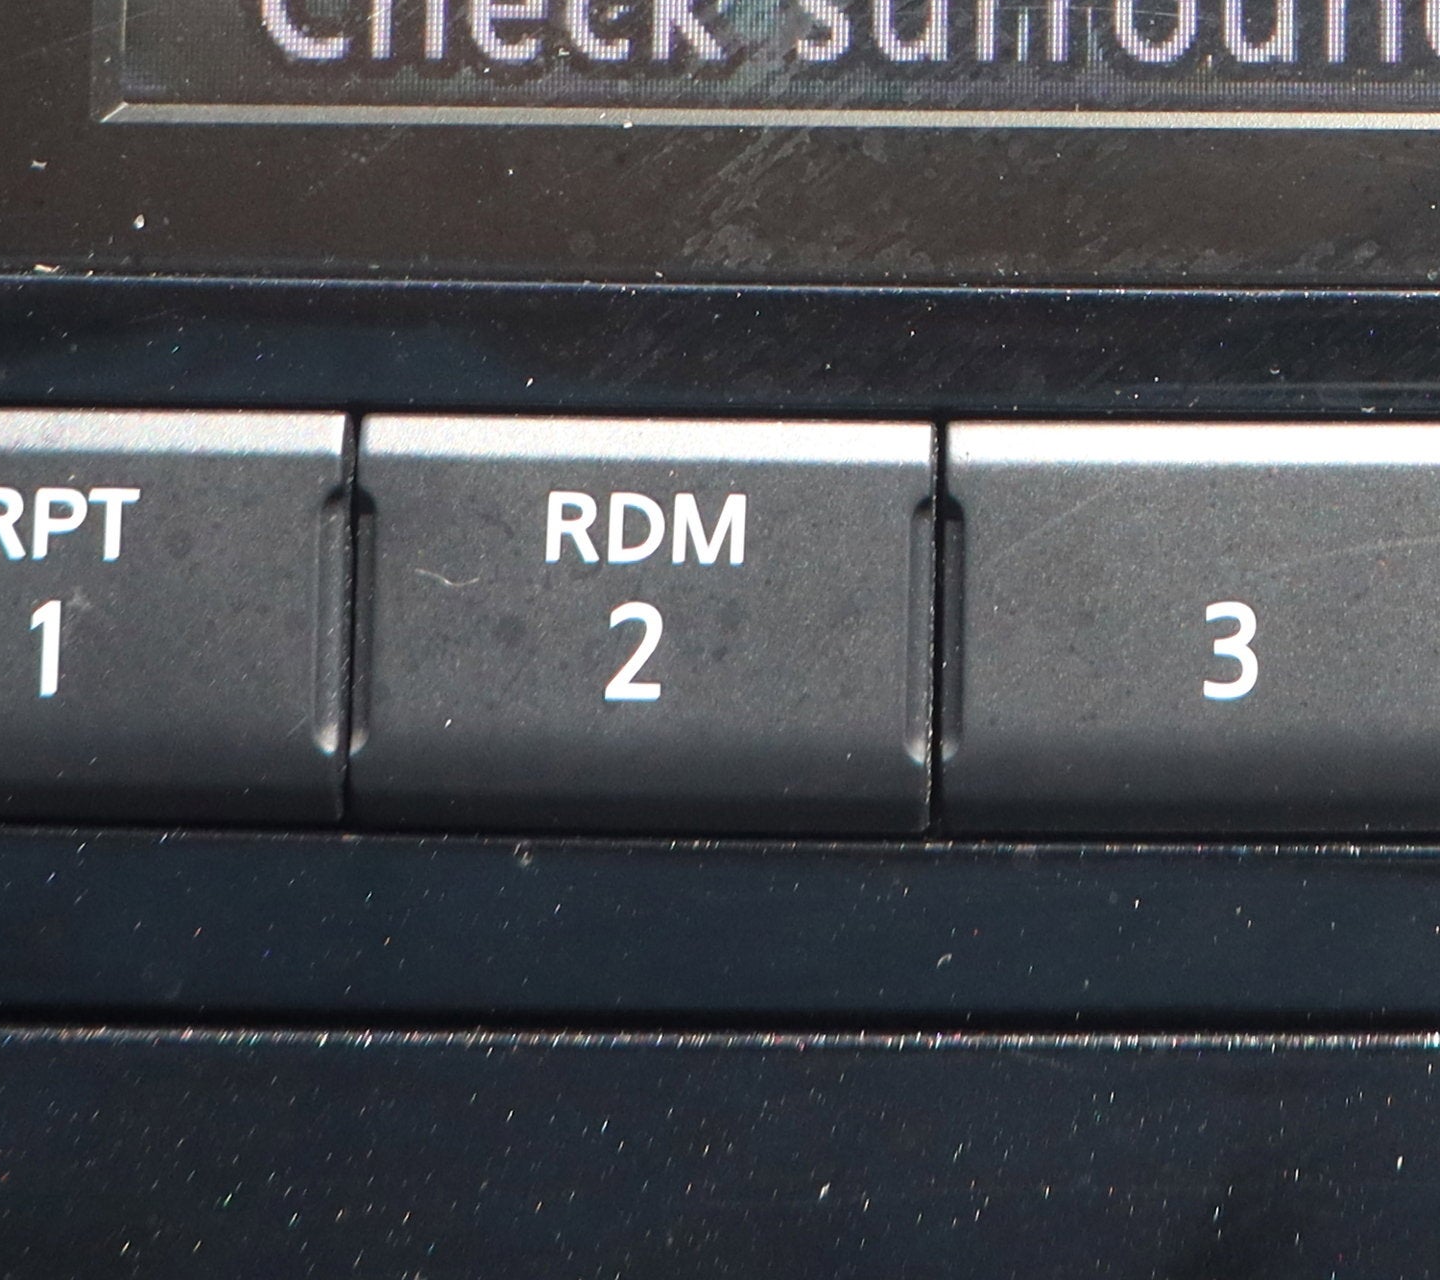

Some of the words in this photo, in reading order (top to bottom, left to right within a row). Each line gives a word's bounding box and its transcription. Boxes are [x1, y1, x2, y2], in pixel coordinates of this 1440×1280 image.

[544, 490, 748, 566] RDM
[29, 599, 63, 698] 1
[603, 601, 664, 702] 2
[1202, 600, 1260, 702] 3
